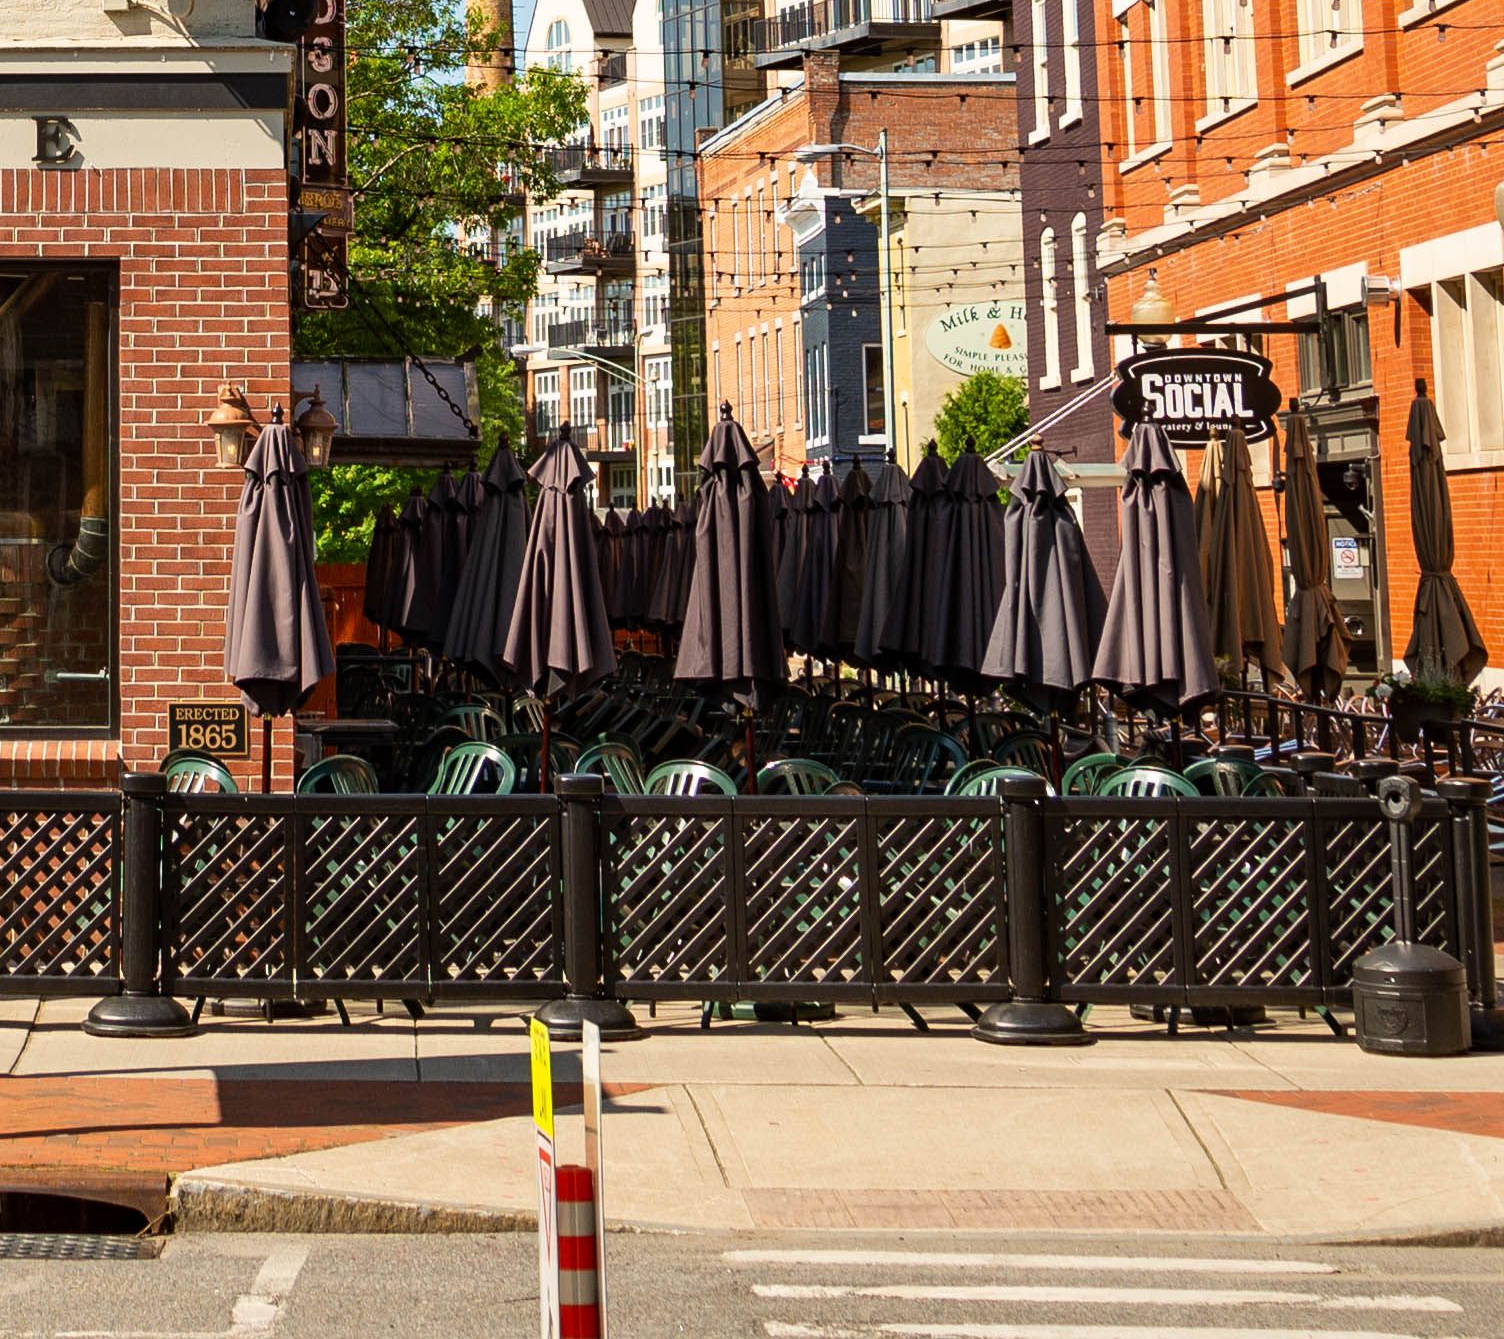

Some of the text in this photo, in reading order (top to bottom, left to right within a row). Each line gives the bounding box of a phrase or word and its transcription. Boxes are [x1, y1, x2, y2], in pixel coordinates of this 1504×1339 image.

[940, 306, 979, 332] Milk
[987, 306, 1001, 319] &
[954, 346, 988, 361] SIMPLE
[943, 354, 963, 369] FOR
[1164, 373, 1242, 383] DOWNTOWN
[1141, 373, 1254, 419] SOCIAL
[1206, 422, 1232, 431] loun
[176, 707, 240, 720] ERECTED
[178, 724, 237, 749] 1865
